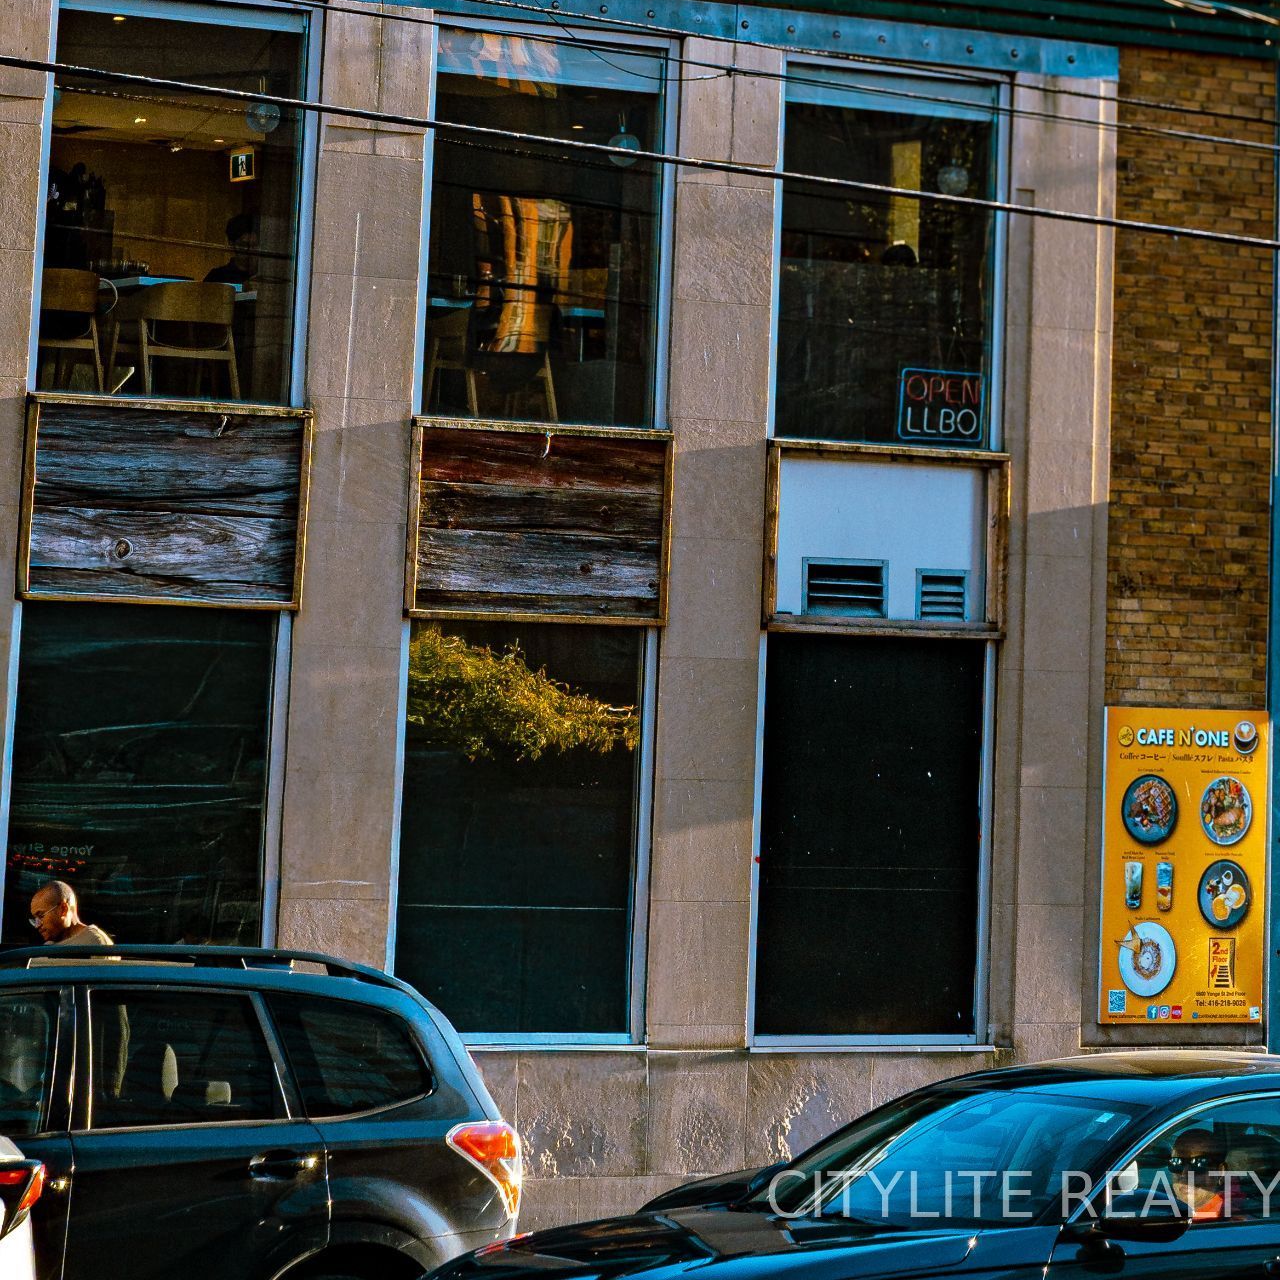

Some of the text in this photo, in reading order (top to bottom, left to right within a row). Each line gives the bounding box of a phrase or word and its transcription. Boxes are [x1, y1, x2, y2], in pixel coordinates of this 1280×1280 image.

[907, 375, 980, 404] OPEN
[906, 406, 978, 435] LLBO
[1136, 728, 1174, 746] CAFE
[1119, 752, 1140, 760] Coffee
[1212, 942, 1228, 954] 2nd
